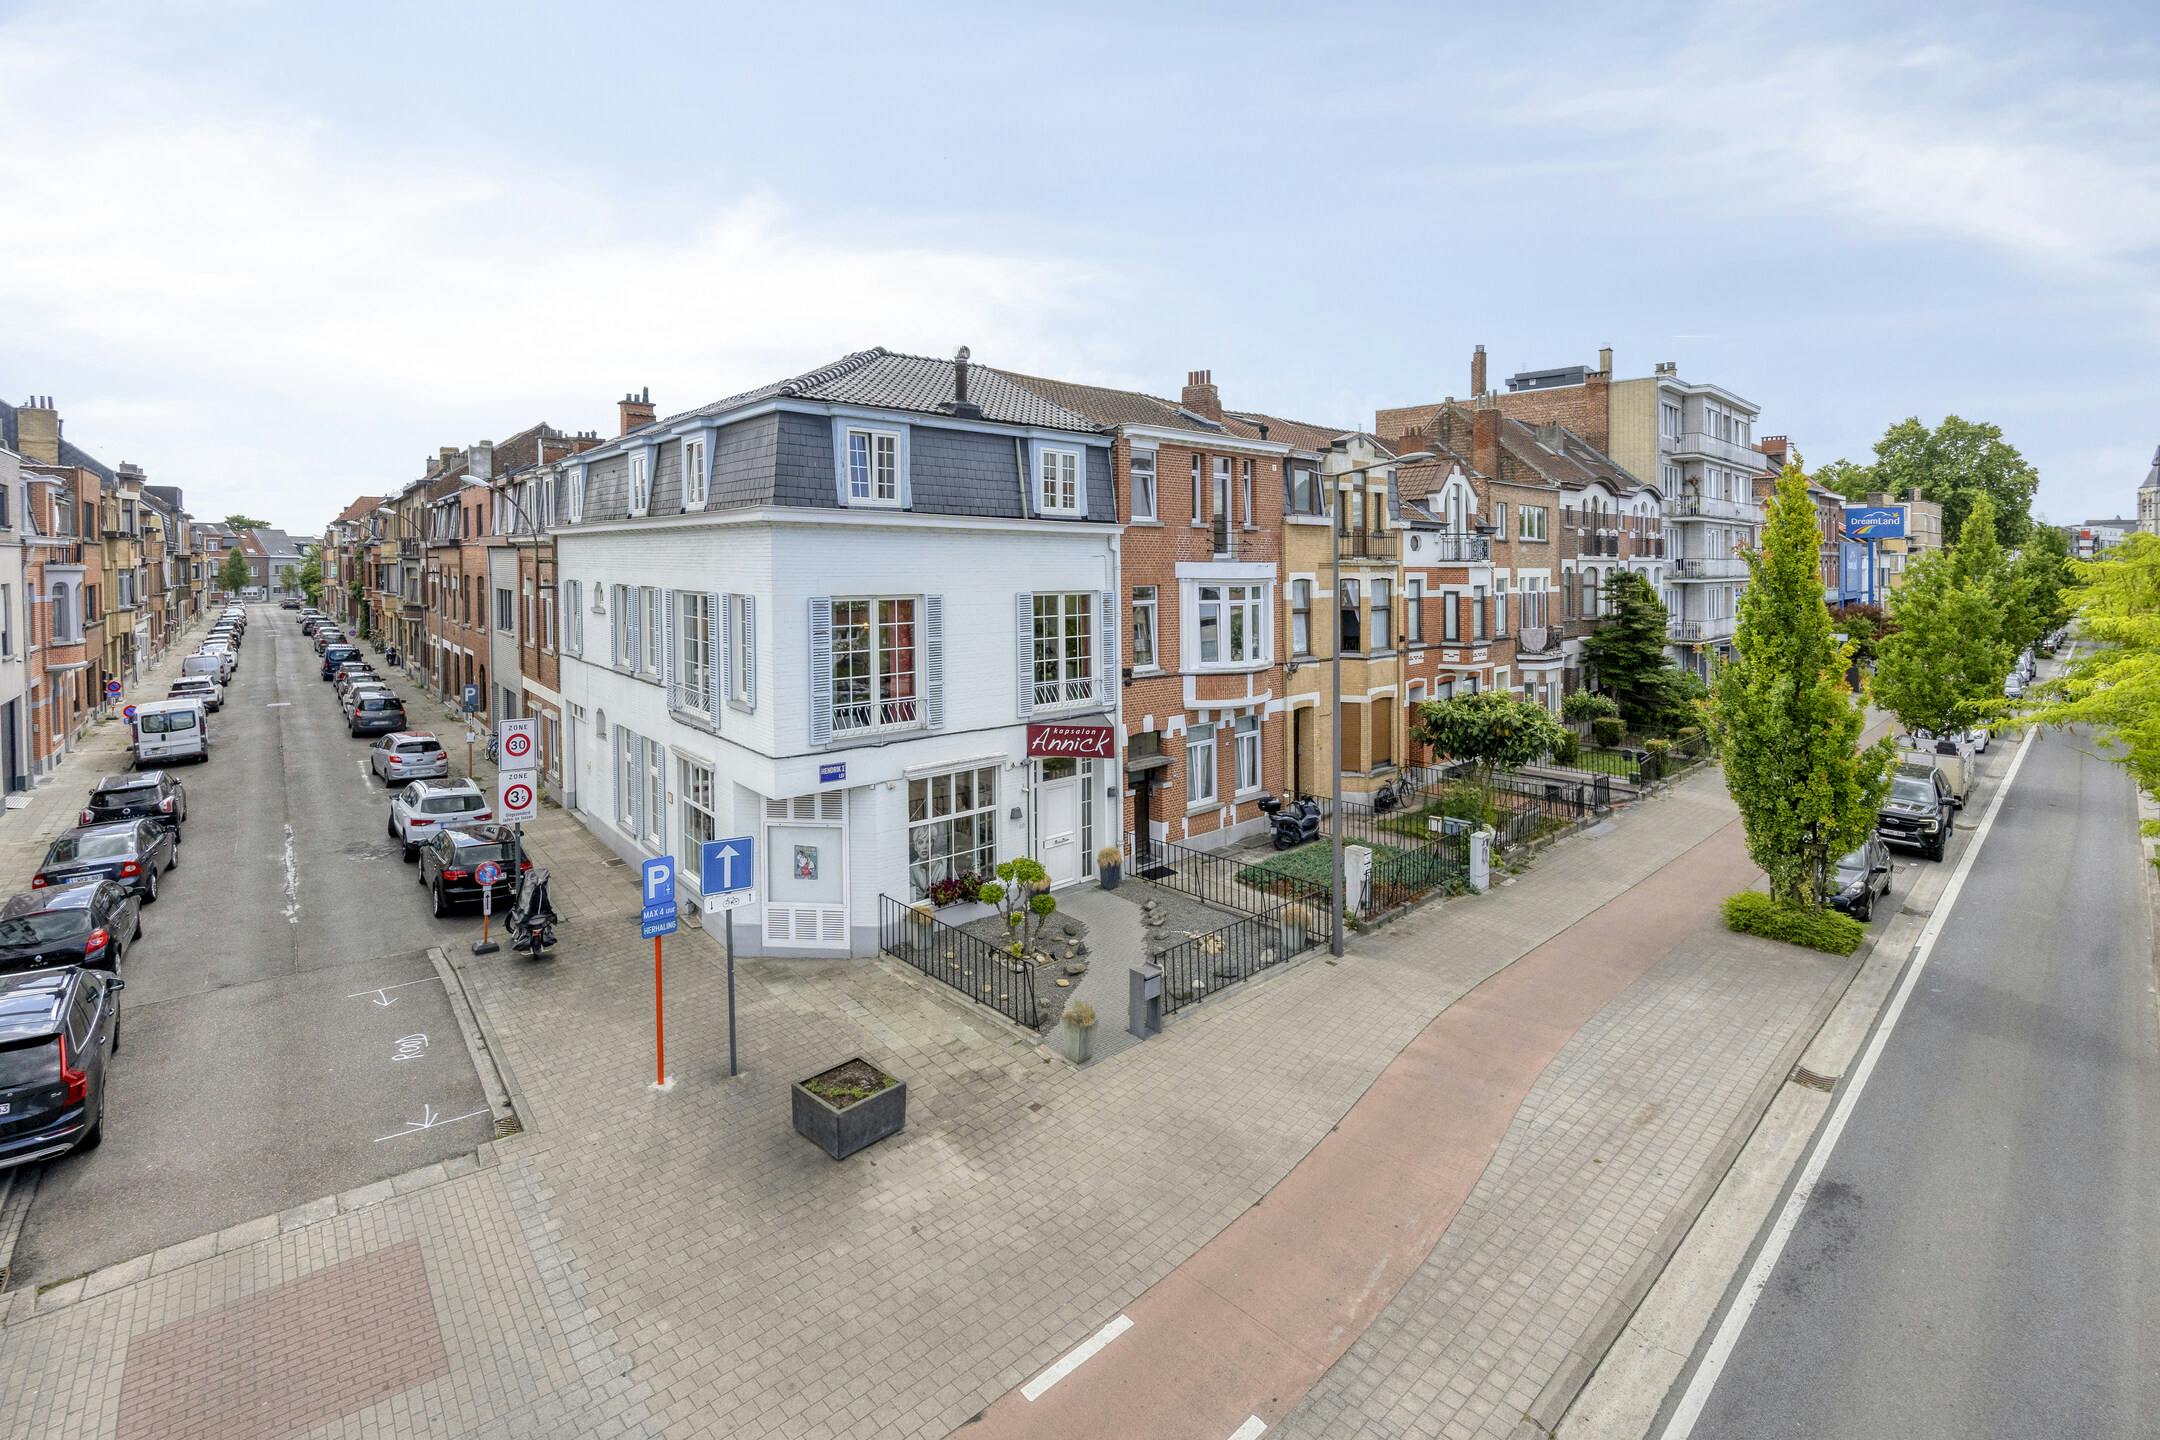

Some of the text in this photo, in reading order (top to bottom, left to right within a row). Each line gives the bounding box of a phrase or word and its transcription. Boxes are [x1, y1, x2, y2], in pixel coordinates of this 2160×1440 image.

[1851, 517, 1900, 525] DreamLand
[465, 687, 476, 702] P
[1053, 727, 1096, 736] kapsalon
[510, 739, 526, 750] 30
[1031, 727, 1110, 756] Annick
[647, 864, 670, 899] P
[643, 909, 659, 919] MAX
[659, 907, 664, 915] 4
[643, 920, 676, 935] HERHALING
